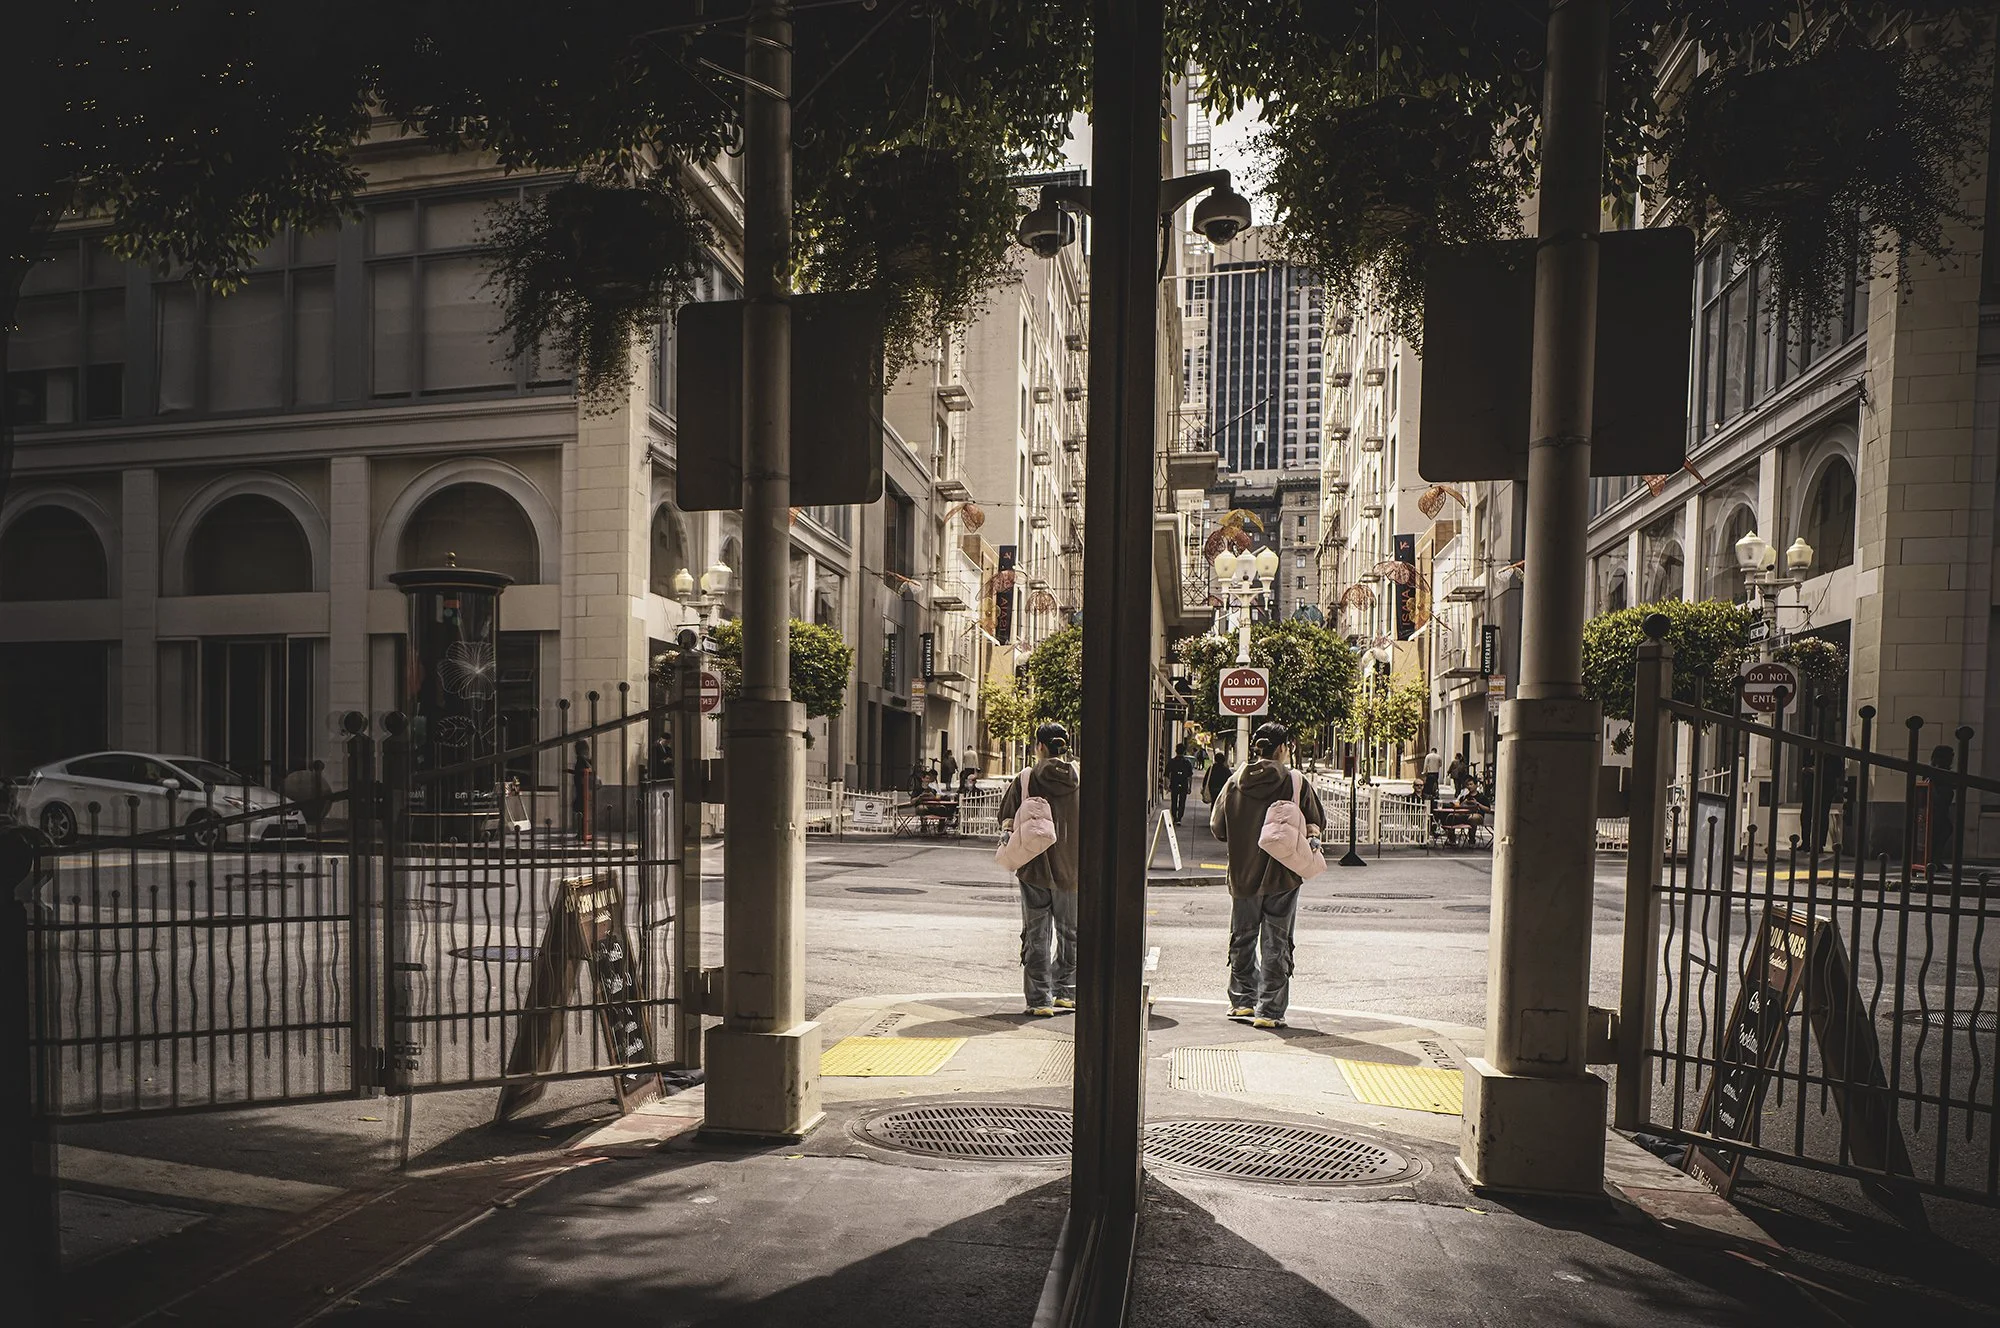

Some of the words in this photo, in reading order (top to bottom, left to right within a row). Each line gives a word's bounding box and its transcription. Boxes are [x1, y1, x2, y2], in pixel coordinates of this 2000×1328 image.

[1484, 631, 1492, 673] CAMERAWEST
[1750, 673, 1763, 681] DO
[1769, 672, 1789, 681] NOT
[1227, 677, 1239, 686] DO
[1244, 677, 1261, 686] NOT
[1230, 698, 1257, 706] ENTER
[1752, 694, 1777, 703] ENTE
